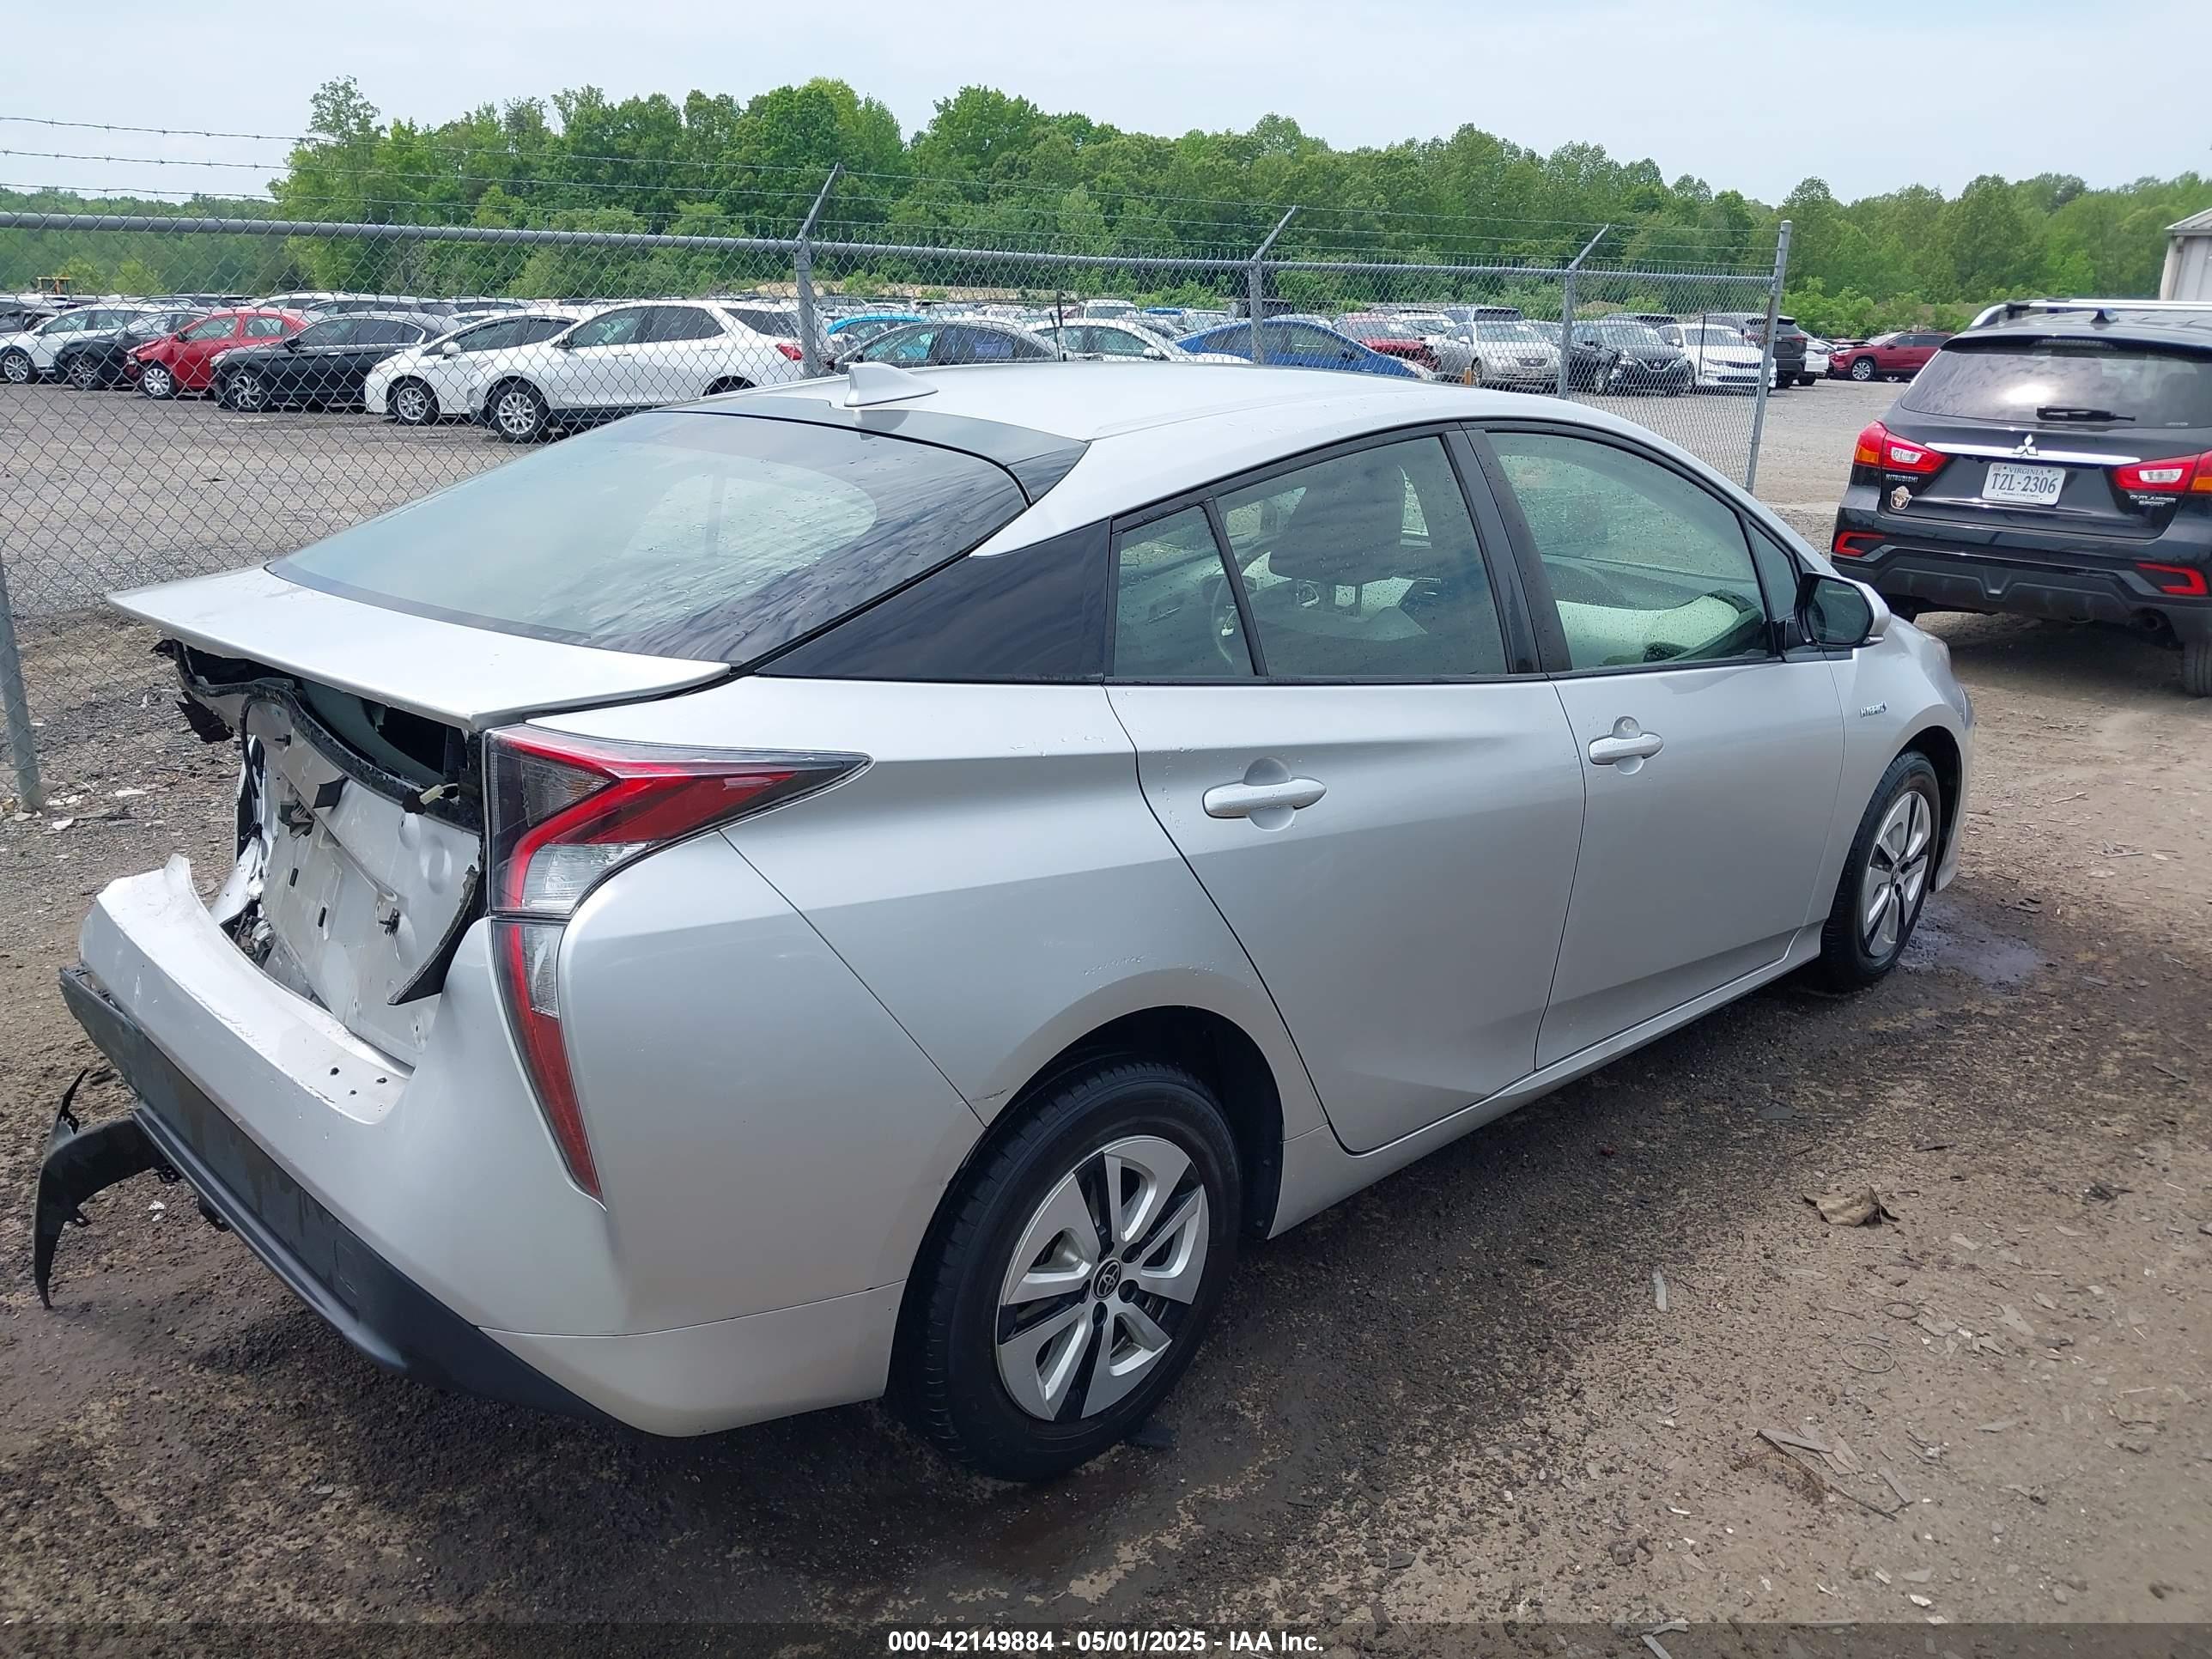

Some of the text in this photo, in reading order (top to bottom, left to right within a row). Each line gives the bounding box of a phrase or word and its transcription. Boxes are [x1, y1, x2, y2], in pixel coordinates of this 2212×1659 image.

[2009, 466, 2044, 476] VIRGINIA
[1991, 472, 2058, 494] TZL-2306
[2130, 495, 2177, 503] OUTLANDER
